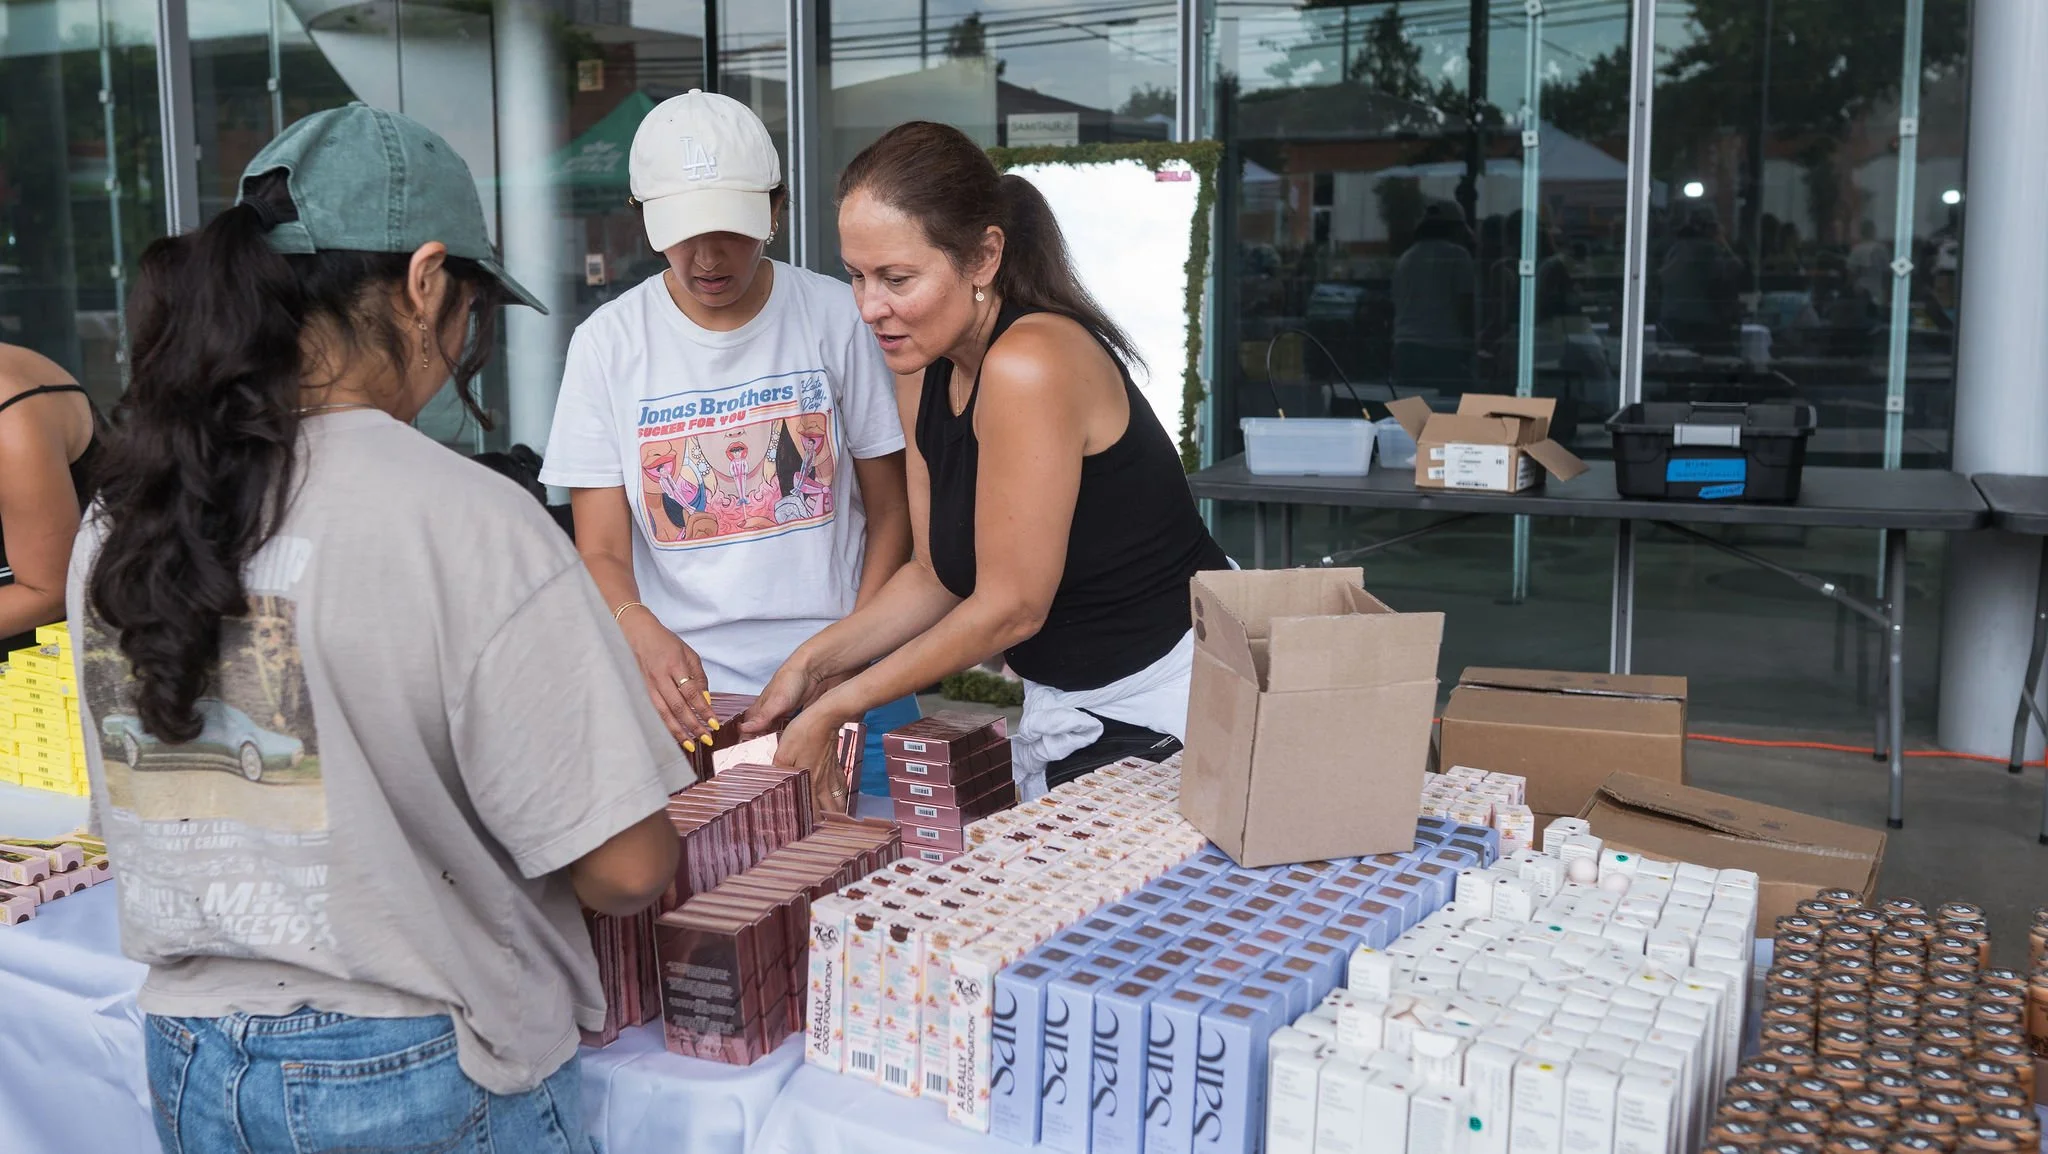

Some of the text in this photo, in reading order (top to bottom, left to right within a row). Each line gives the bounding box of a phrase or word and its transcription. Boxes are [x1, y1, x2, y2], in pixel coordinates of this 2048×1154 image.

[680, 136, 718, 180] LA
[637, 409, 747, 439] SUCKER FOR YOU
[638, 384, 793, 427] Jonas Brothers
[813, 996, 824, 1051] A REALLY
[822, 1025, 830, 1055] GOOD
[956, 1053, 967, 1110] A REALLY
[967, 1083, 975, 1114] GOOD
